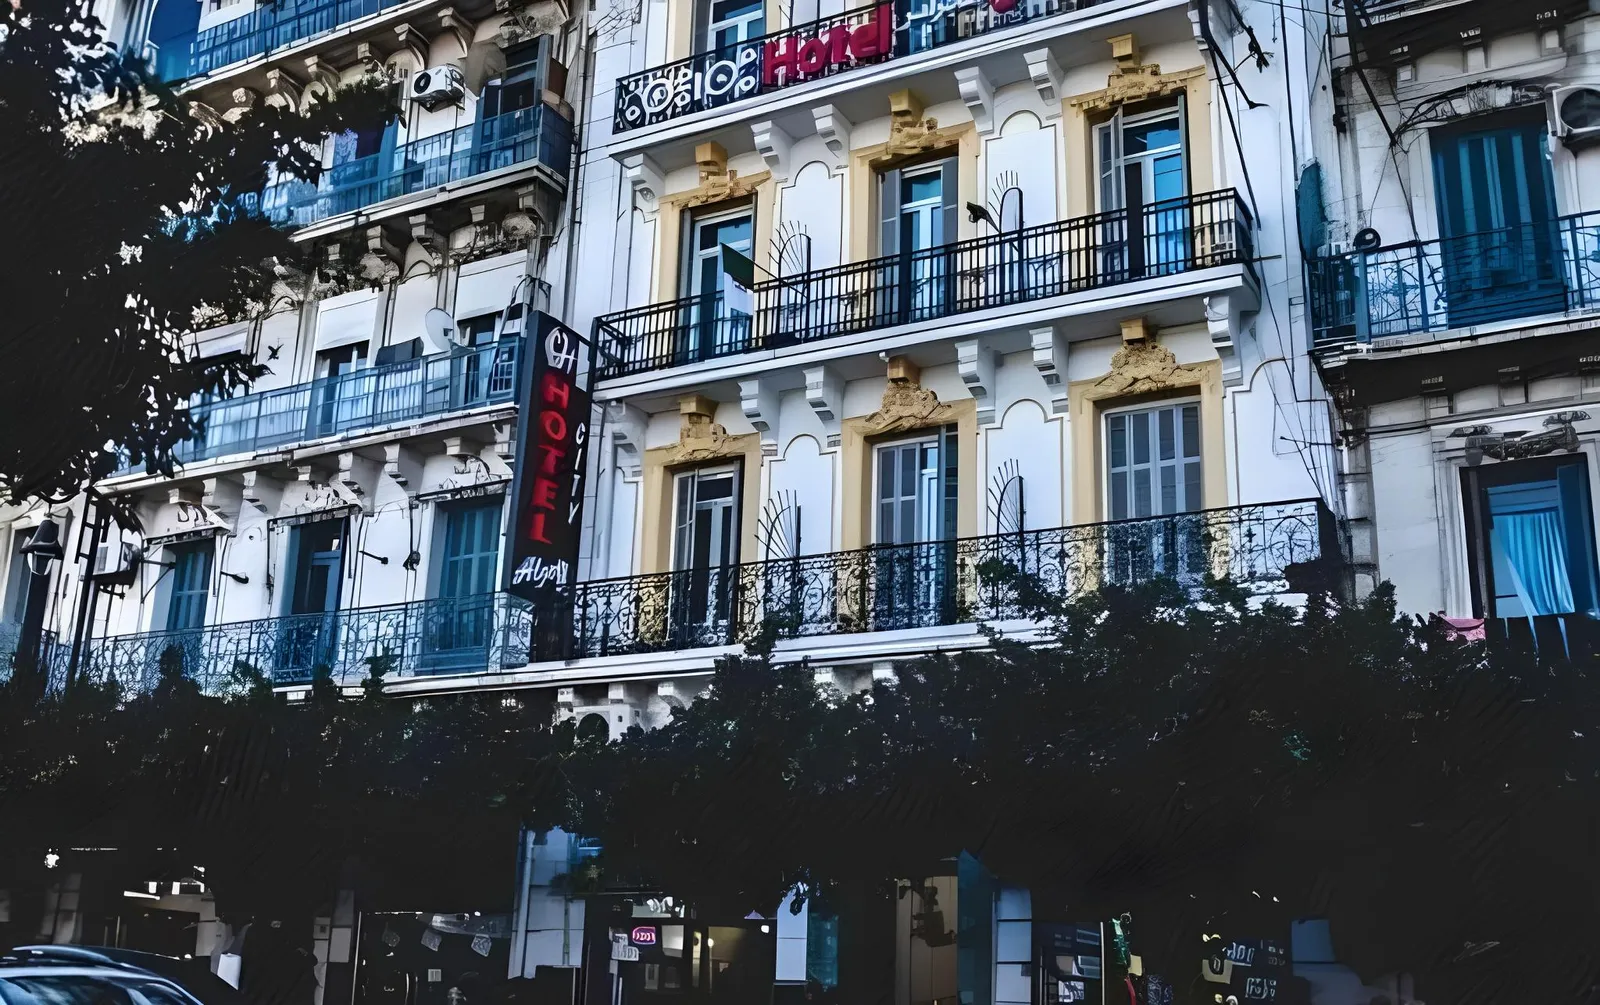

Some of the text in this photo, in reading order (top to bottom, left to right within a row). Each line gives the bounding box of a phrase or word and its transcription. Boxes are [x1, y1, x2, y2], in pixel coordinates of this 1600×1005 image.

[762, 3, 892, 87] Hotel
[530, 371, 570, 544] HOTEL
[568, 421, 586, 525] CITY
